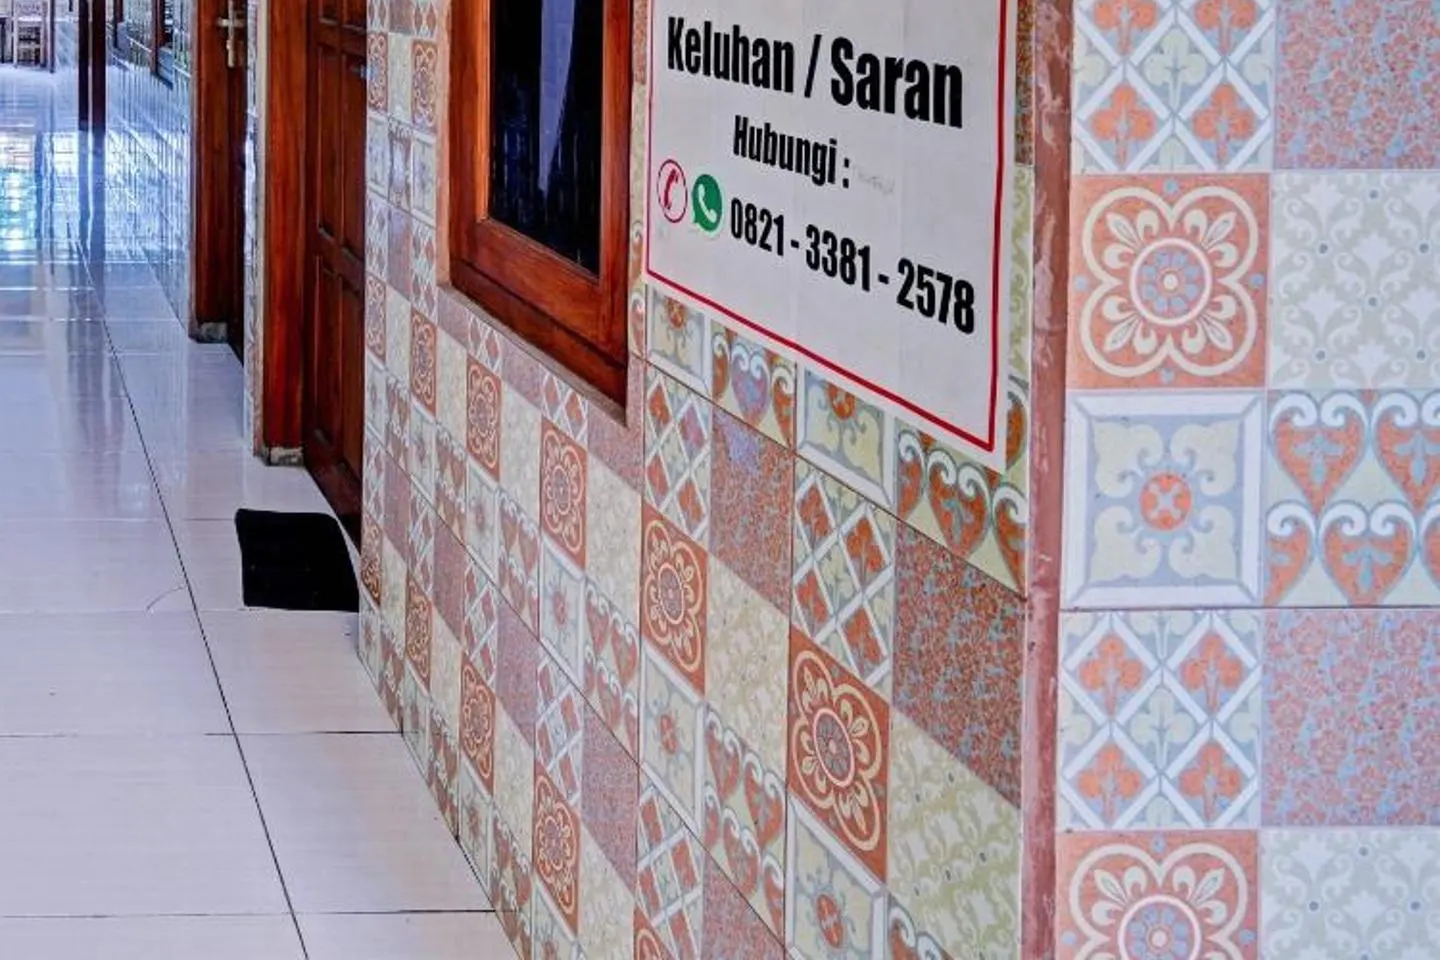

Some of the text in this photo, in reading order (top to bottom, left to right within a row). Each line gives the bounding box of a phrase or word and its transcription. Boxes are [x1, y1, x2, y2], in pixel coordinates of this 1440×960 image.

[667, 16, 794, 93] Keluhan
[830, 37, 963, 128] Saran
[730, 198, 785, 256] 0821
[806, 224, 871, 293] 3381
[897, 257, 976, 335] 2578
